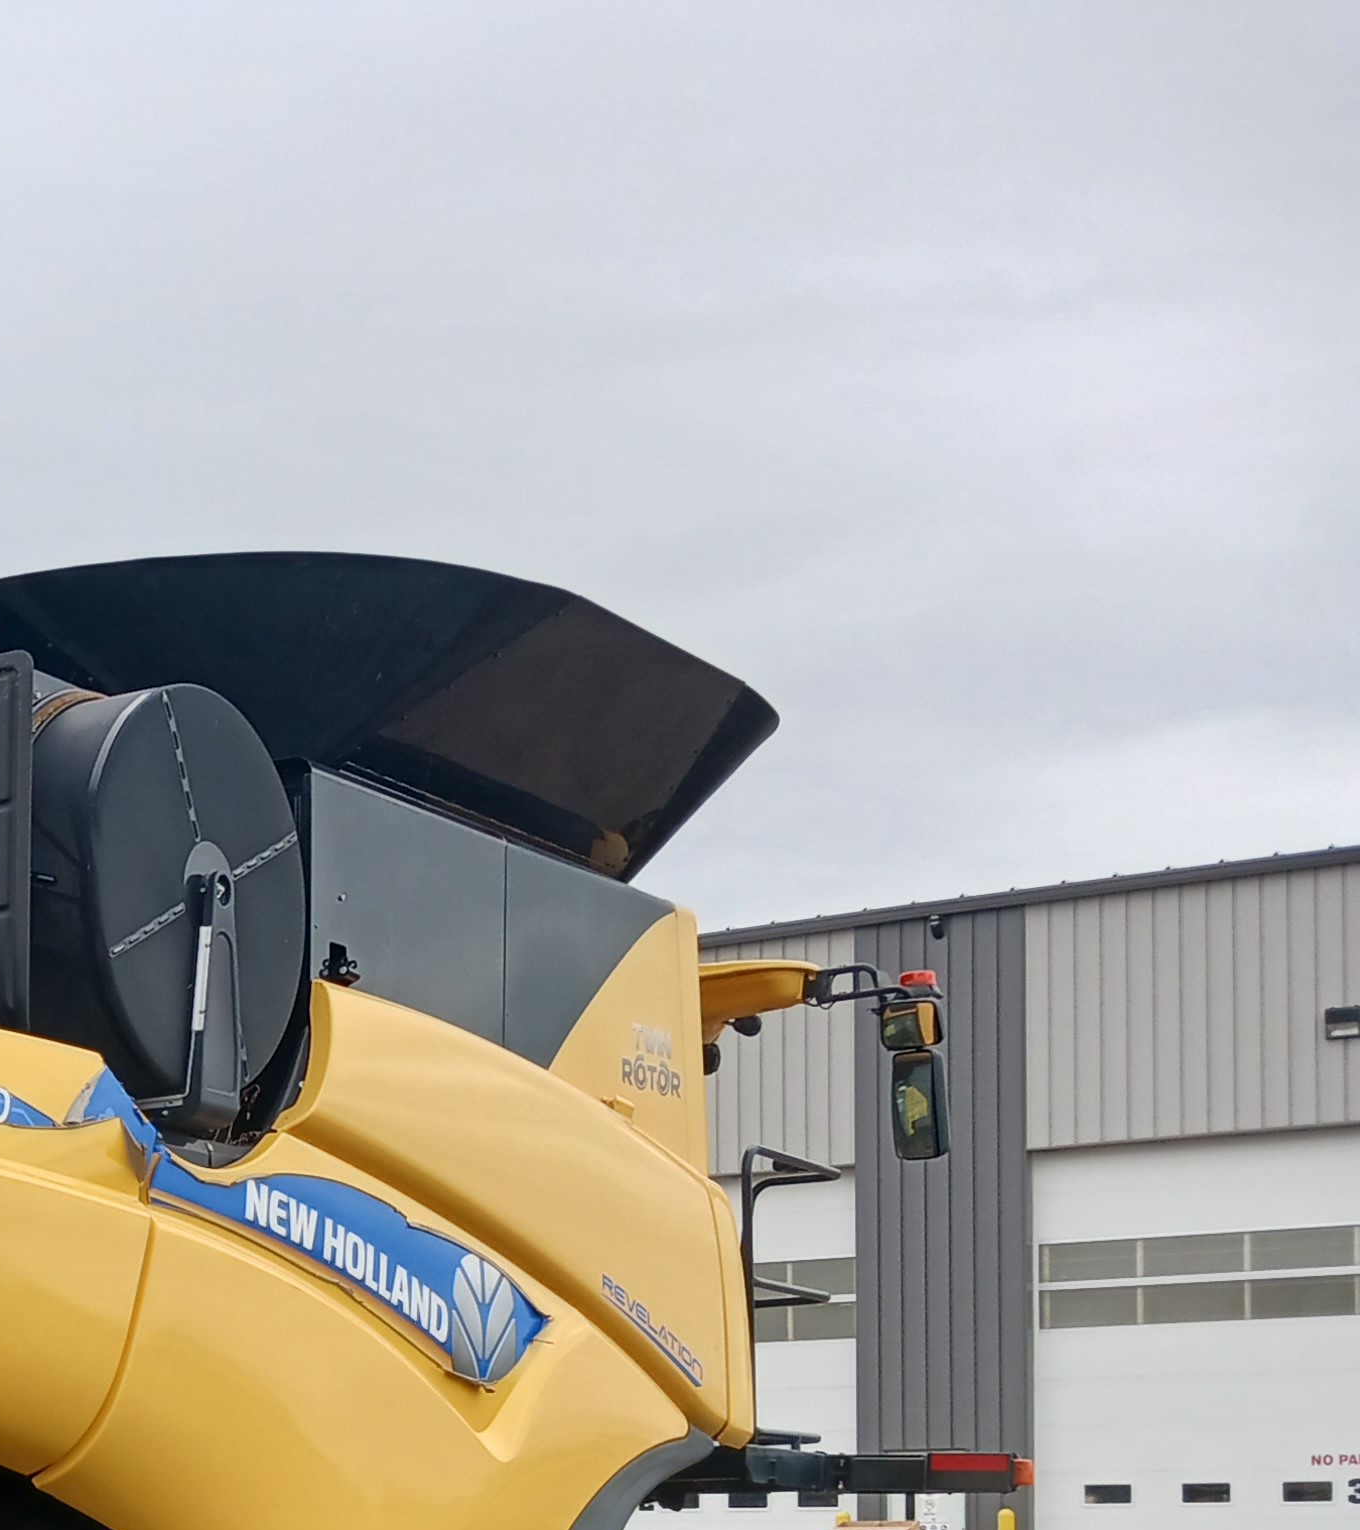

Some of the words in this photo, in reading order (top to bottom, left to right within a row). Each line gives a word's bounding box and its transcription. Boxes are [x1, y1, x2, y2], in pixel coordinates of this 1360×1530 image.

[620, 1053, 682, 1099] ROTOR
[244, 1178, 318, 1251] NEW
[322, 1216, 449, 1344] HOLLAND
[601, 1273, 704, 1381] REVELATION
[1311, 1454, 1334, 1467] NO
[1338, 1454, 1360, 1467] PA
